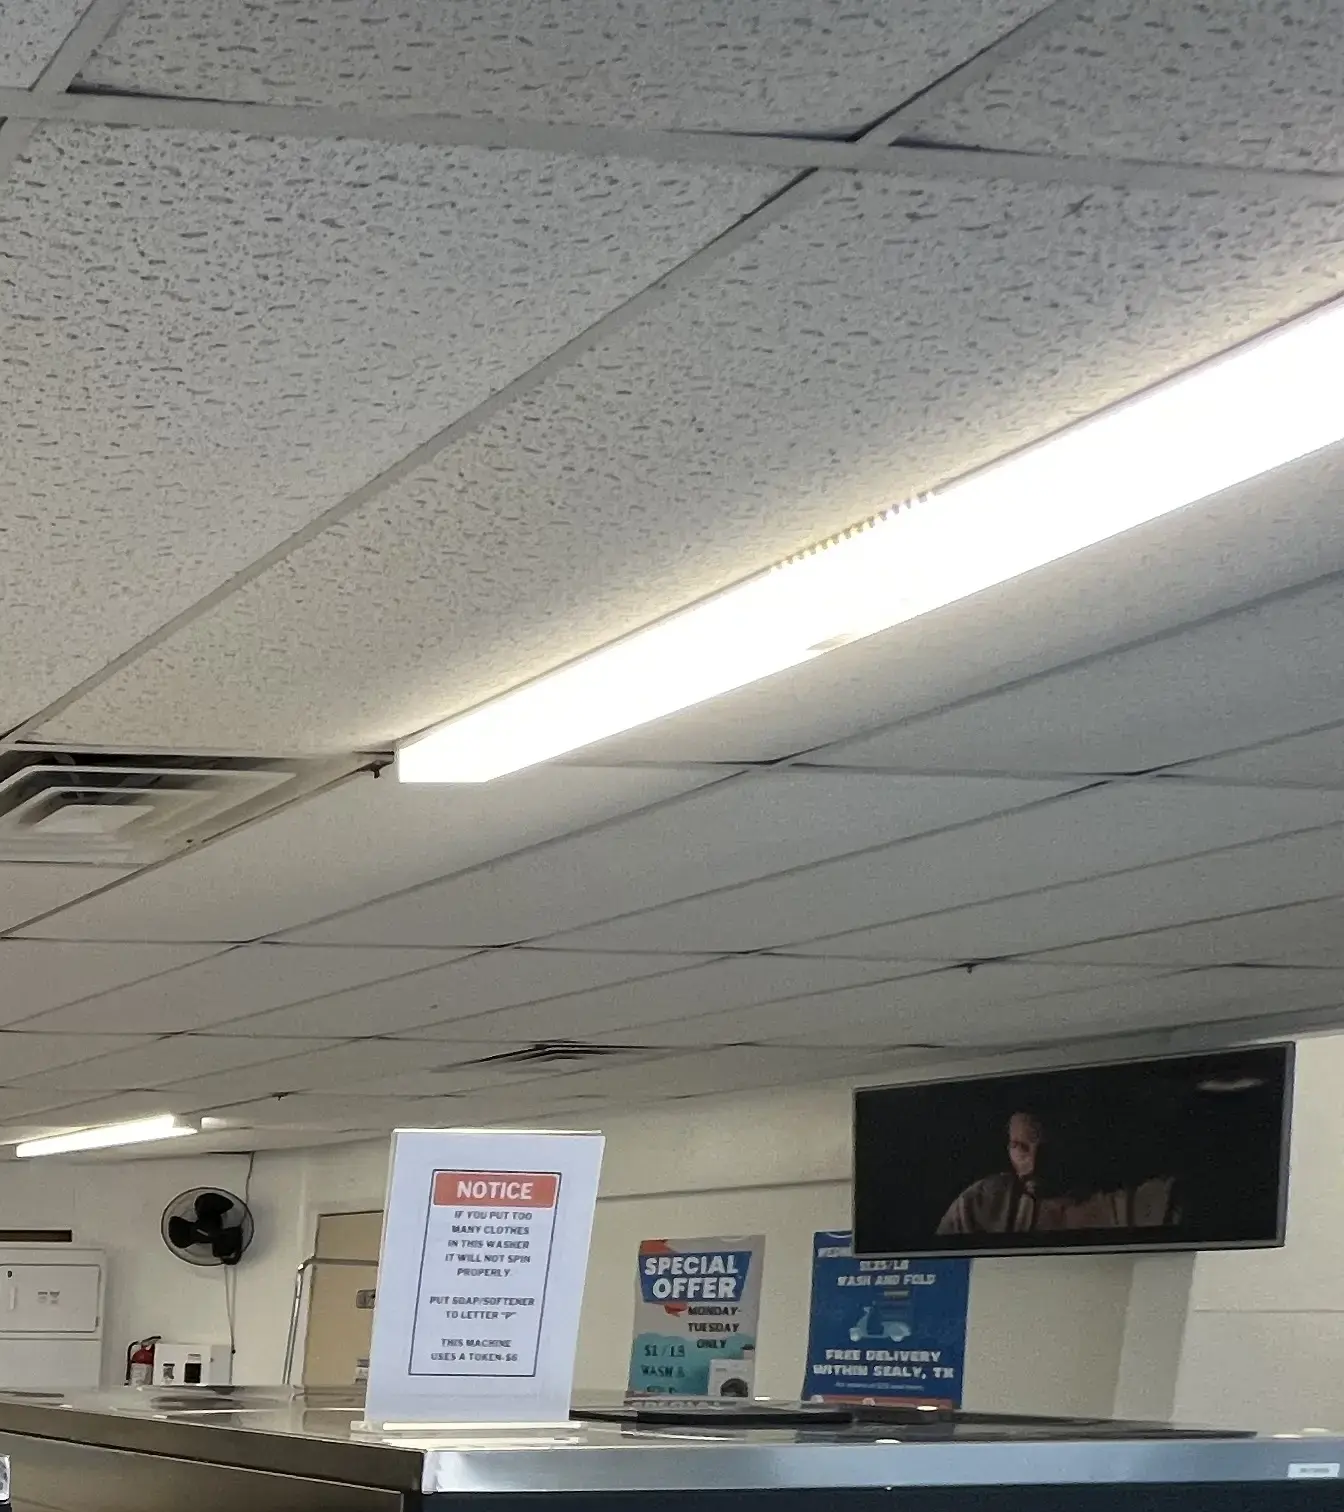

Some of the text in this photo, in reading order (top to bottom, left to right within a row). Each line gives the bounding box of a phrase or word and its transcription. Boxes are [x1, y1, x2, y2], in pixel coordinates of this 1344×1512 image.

[456, 1180, 533, 1200] NOTICE
[454, 1211, 532, 1221] IF YOU PUT TOO
[452, 1225, 529, 1235] MANY CLOTHES
[448, 1240, 529, 1249] IN THIS WASHER
[445, 1253, 531, 1264] IT WILL NOT SPIN
[644, 1255, 738, 1275] SPECIAL
[903, 1274, 936, 1285] FOLD
[652, 1277, 736, 1299] OFFER
[429, 1297, 449, 1305] PUT
[446, 1311, 458, 1319] TO
[461, 1311, 498, 1319] LETTER
[688, 1322, 740, 1332] TUESDAY
[441, 1339, 512, 1348] THIS MACHINE
[696, 1339, 727, 1348] ONLY
[431, 1353, 456, 1361] USES
[458, 1353, 466, 1361] A
[825, 1349, 941, 1362] FREE DELIVERY
[640, 1365, 673, 1377] WASH
[813, 1365, 954, 1379] WITHIN SEALY, TX
